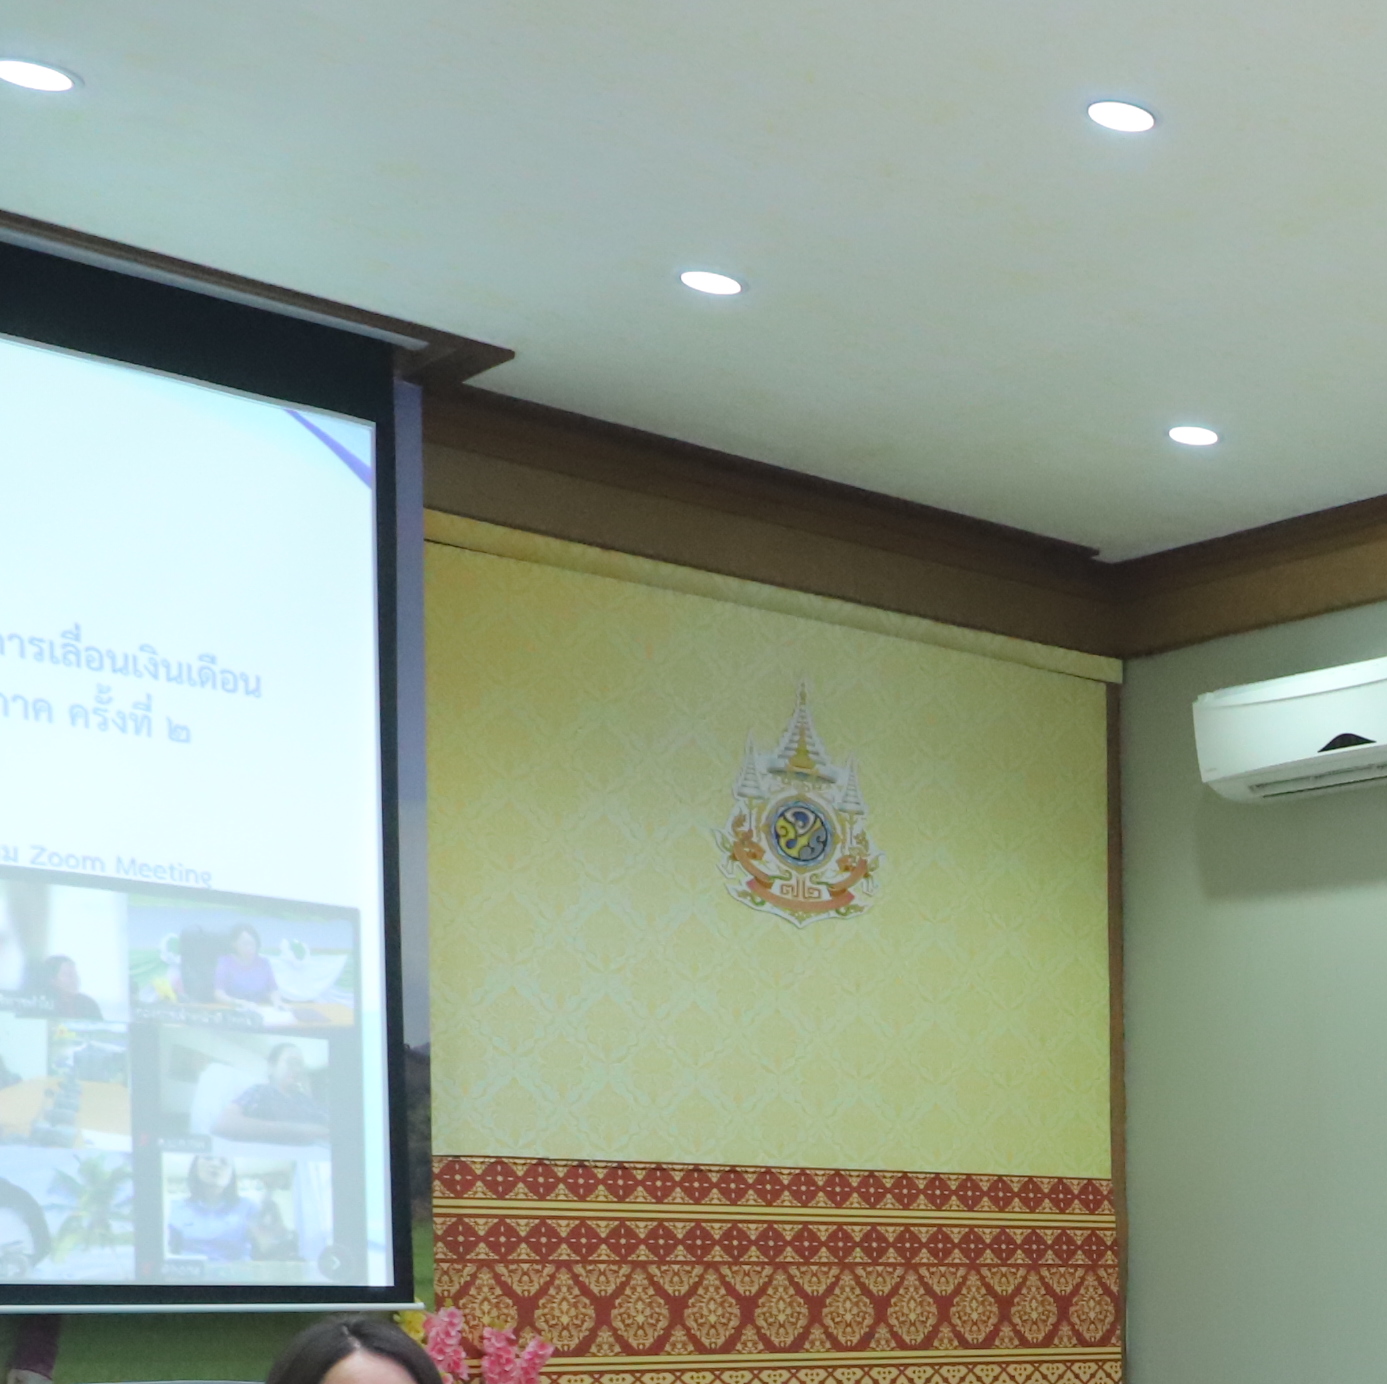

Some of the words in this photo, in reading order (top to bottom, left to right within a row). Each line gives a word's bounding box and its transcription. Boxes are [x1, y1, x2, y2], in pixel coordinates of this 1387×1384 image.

[68, 682, 153, 738] ครั้งที่
[165, 716, 191, 743] ๒
[30, 844, 106, 873] Zoom
[115, 855, 212, 889] Meeting
